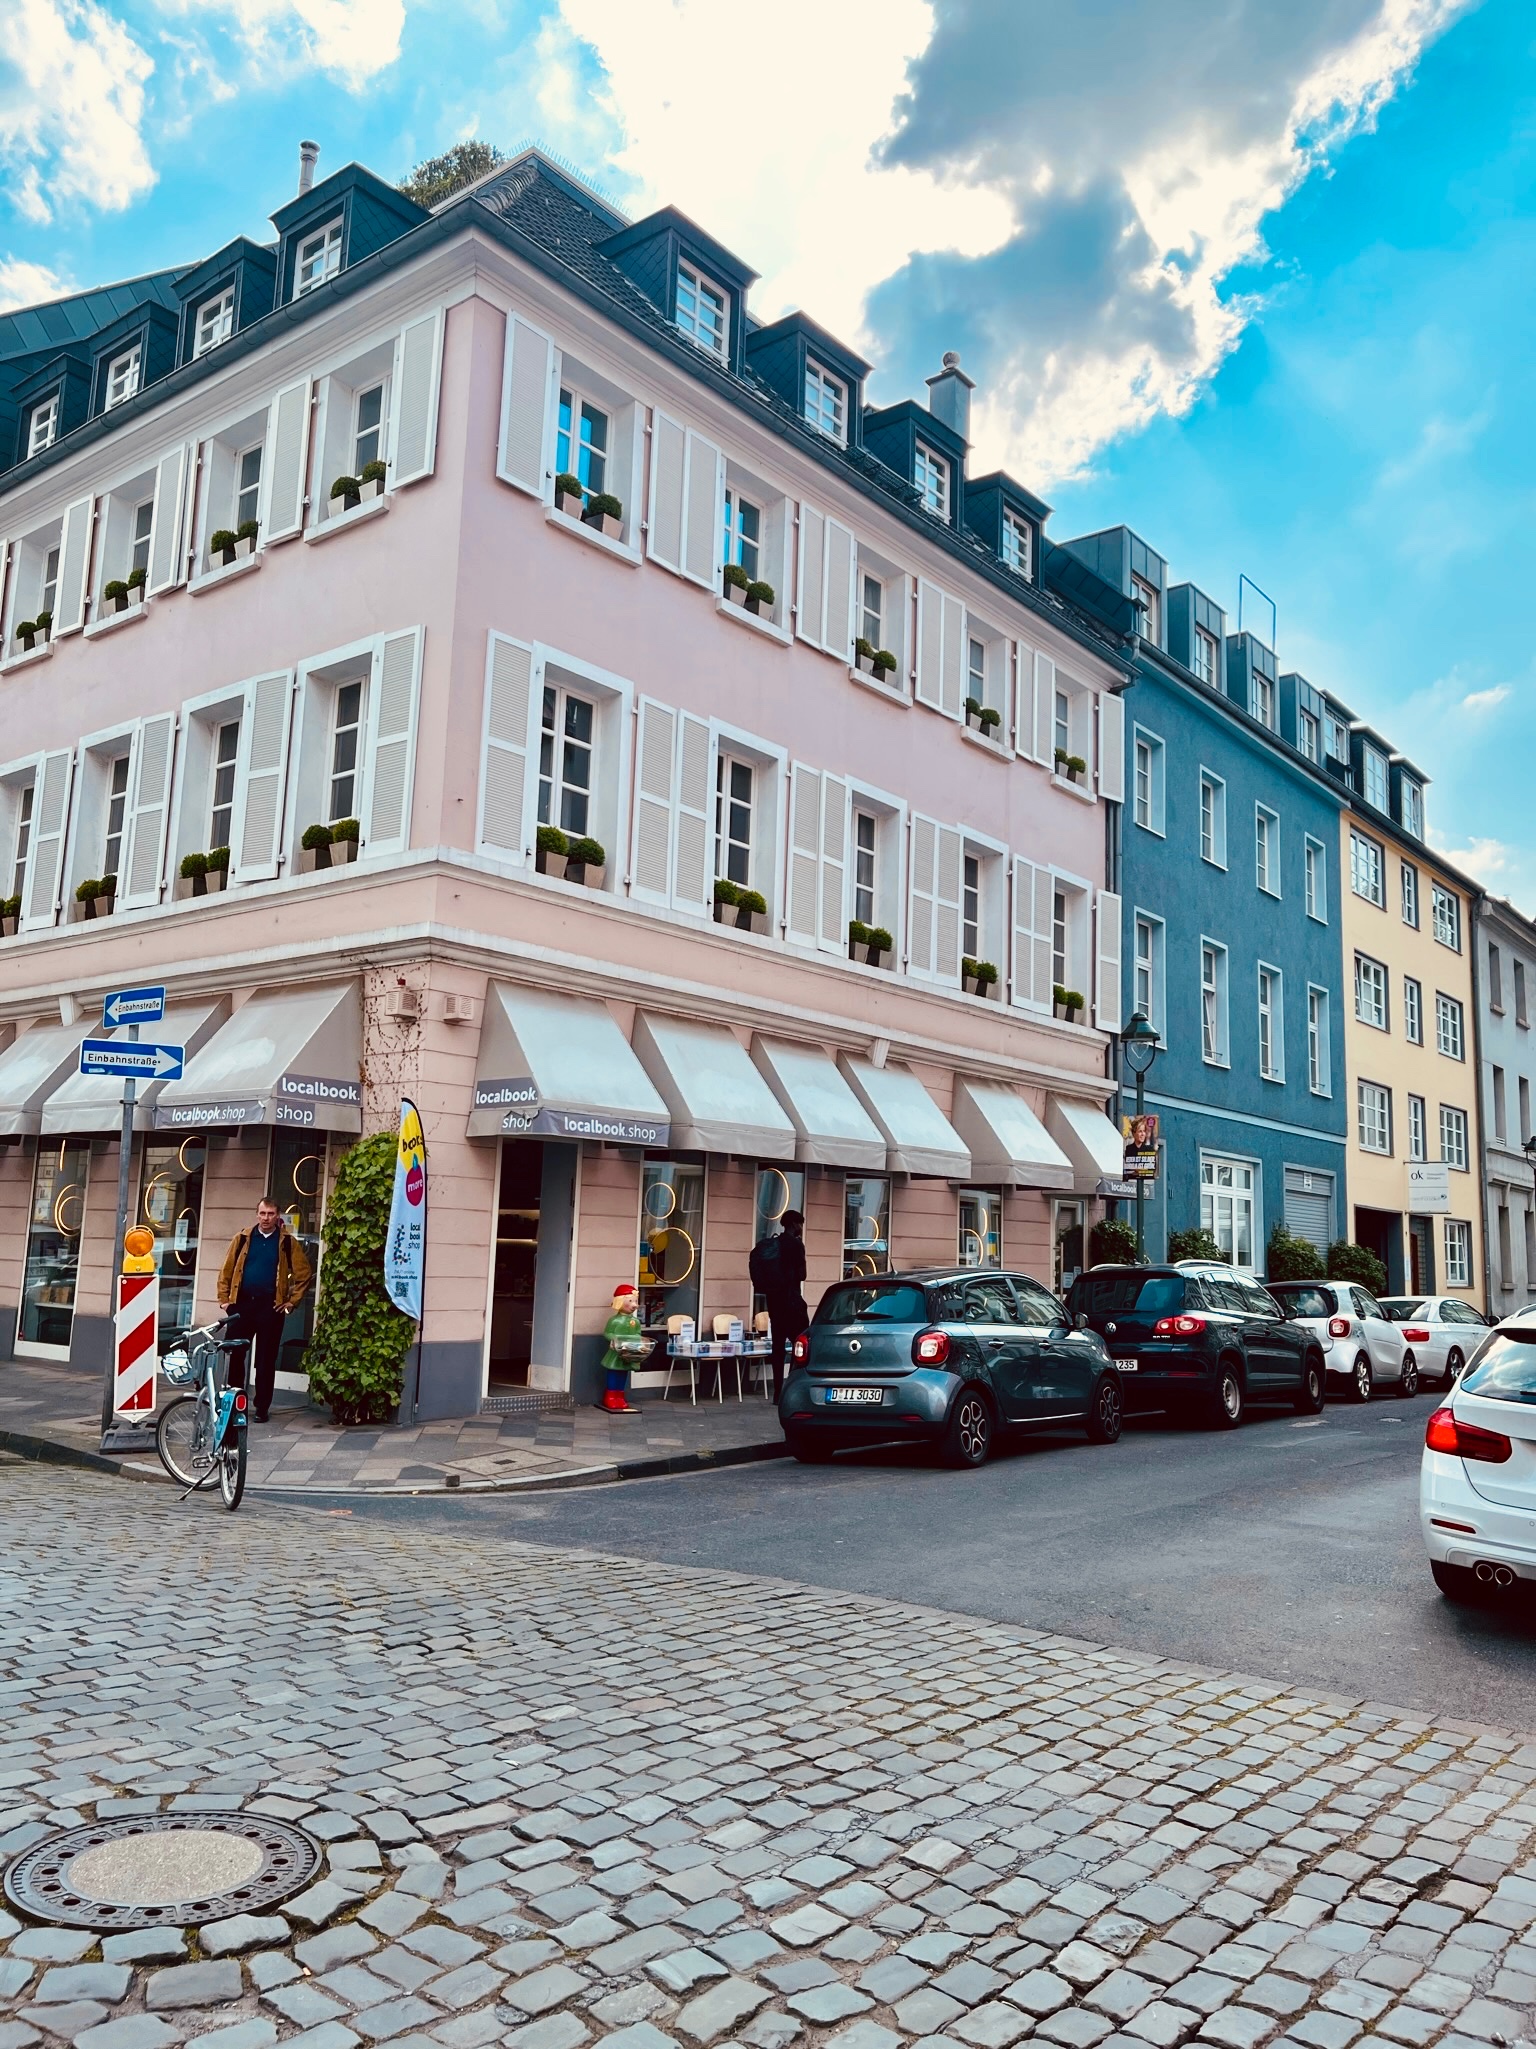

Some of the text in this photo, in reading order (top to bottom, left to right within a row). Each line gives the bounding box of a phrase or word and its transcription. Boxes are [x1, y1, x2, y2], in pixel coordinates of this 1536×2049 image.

[118, 1000, 160, 1013] Einbahnstraße
[88, 1053, 158, 1066] Einbahnstraße
[282, 1077, 360, 1100] localbook.
[475, 1086, 538, 1105] localbook.
[171, 1107, 246, 1123] localbook.shop
[276, 1105, 313, 1124] shop
[502, 1114, 532, 1131] shop
[564, 1116, 657, 1142] localbook.shop
[408, 1179, 423, 1193] more
[410, 1222, 421, 1231] local
[1118, 1360, 1135, 1370] 235
[831, 1389, 838, 1400] D
[856, 1390, 881, 1401] 3030
